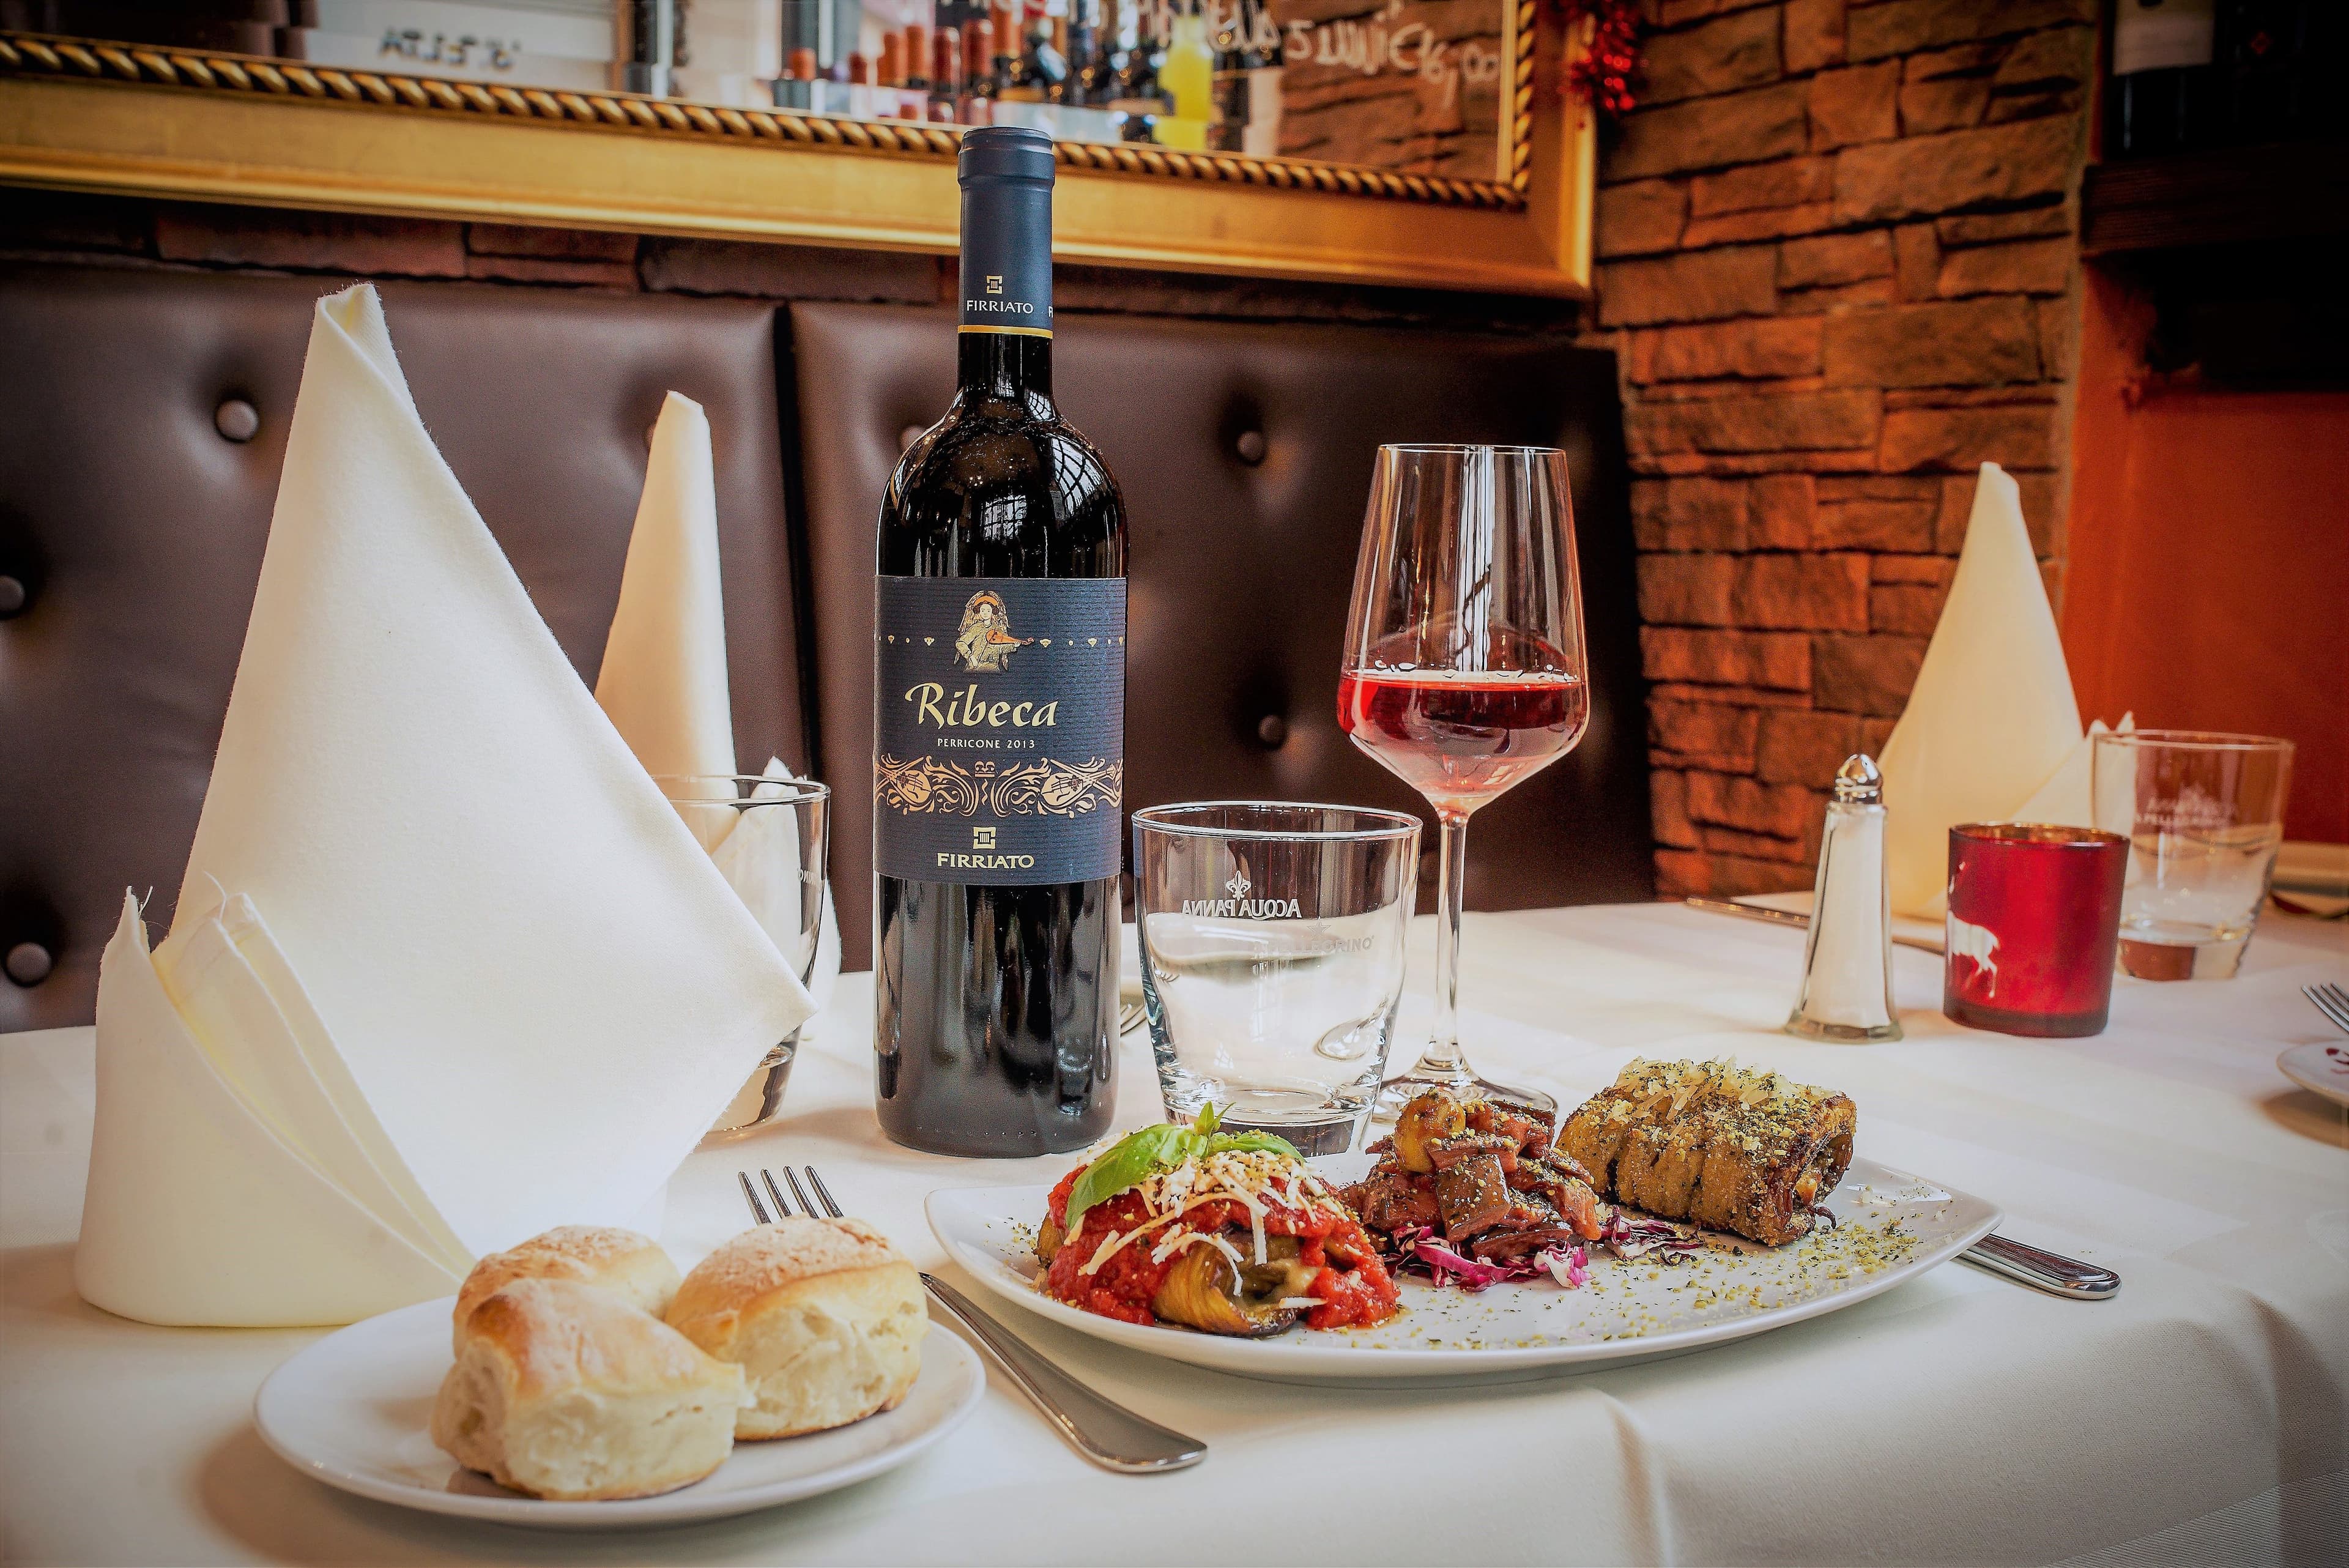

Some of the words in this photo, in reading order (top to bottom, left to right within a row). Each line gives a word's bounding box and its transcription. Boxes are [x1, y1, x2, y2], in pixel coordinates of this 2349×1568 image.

[967, 300, 1034, 314] FIRRIATO
[905, 682, 1058, 729] Ribeca
[937, 738, 1001, 748] PERRICONE
[1007, 740, 1035, 748] 2013
[937, 853, 1034, 868] FIRRIATO
